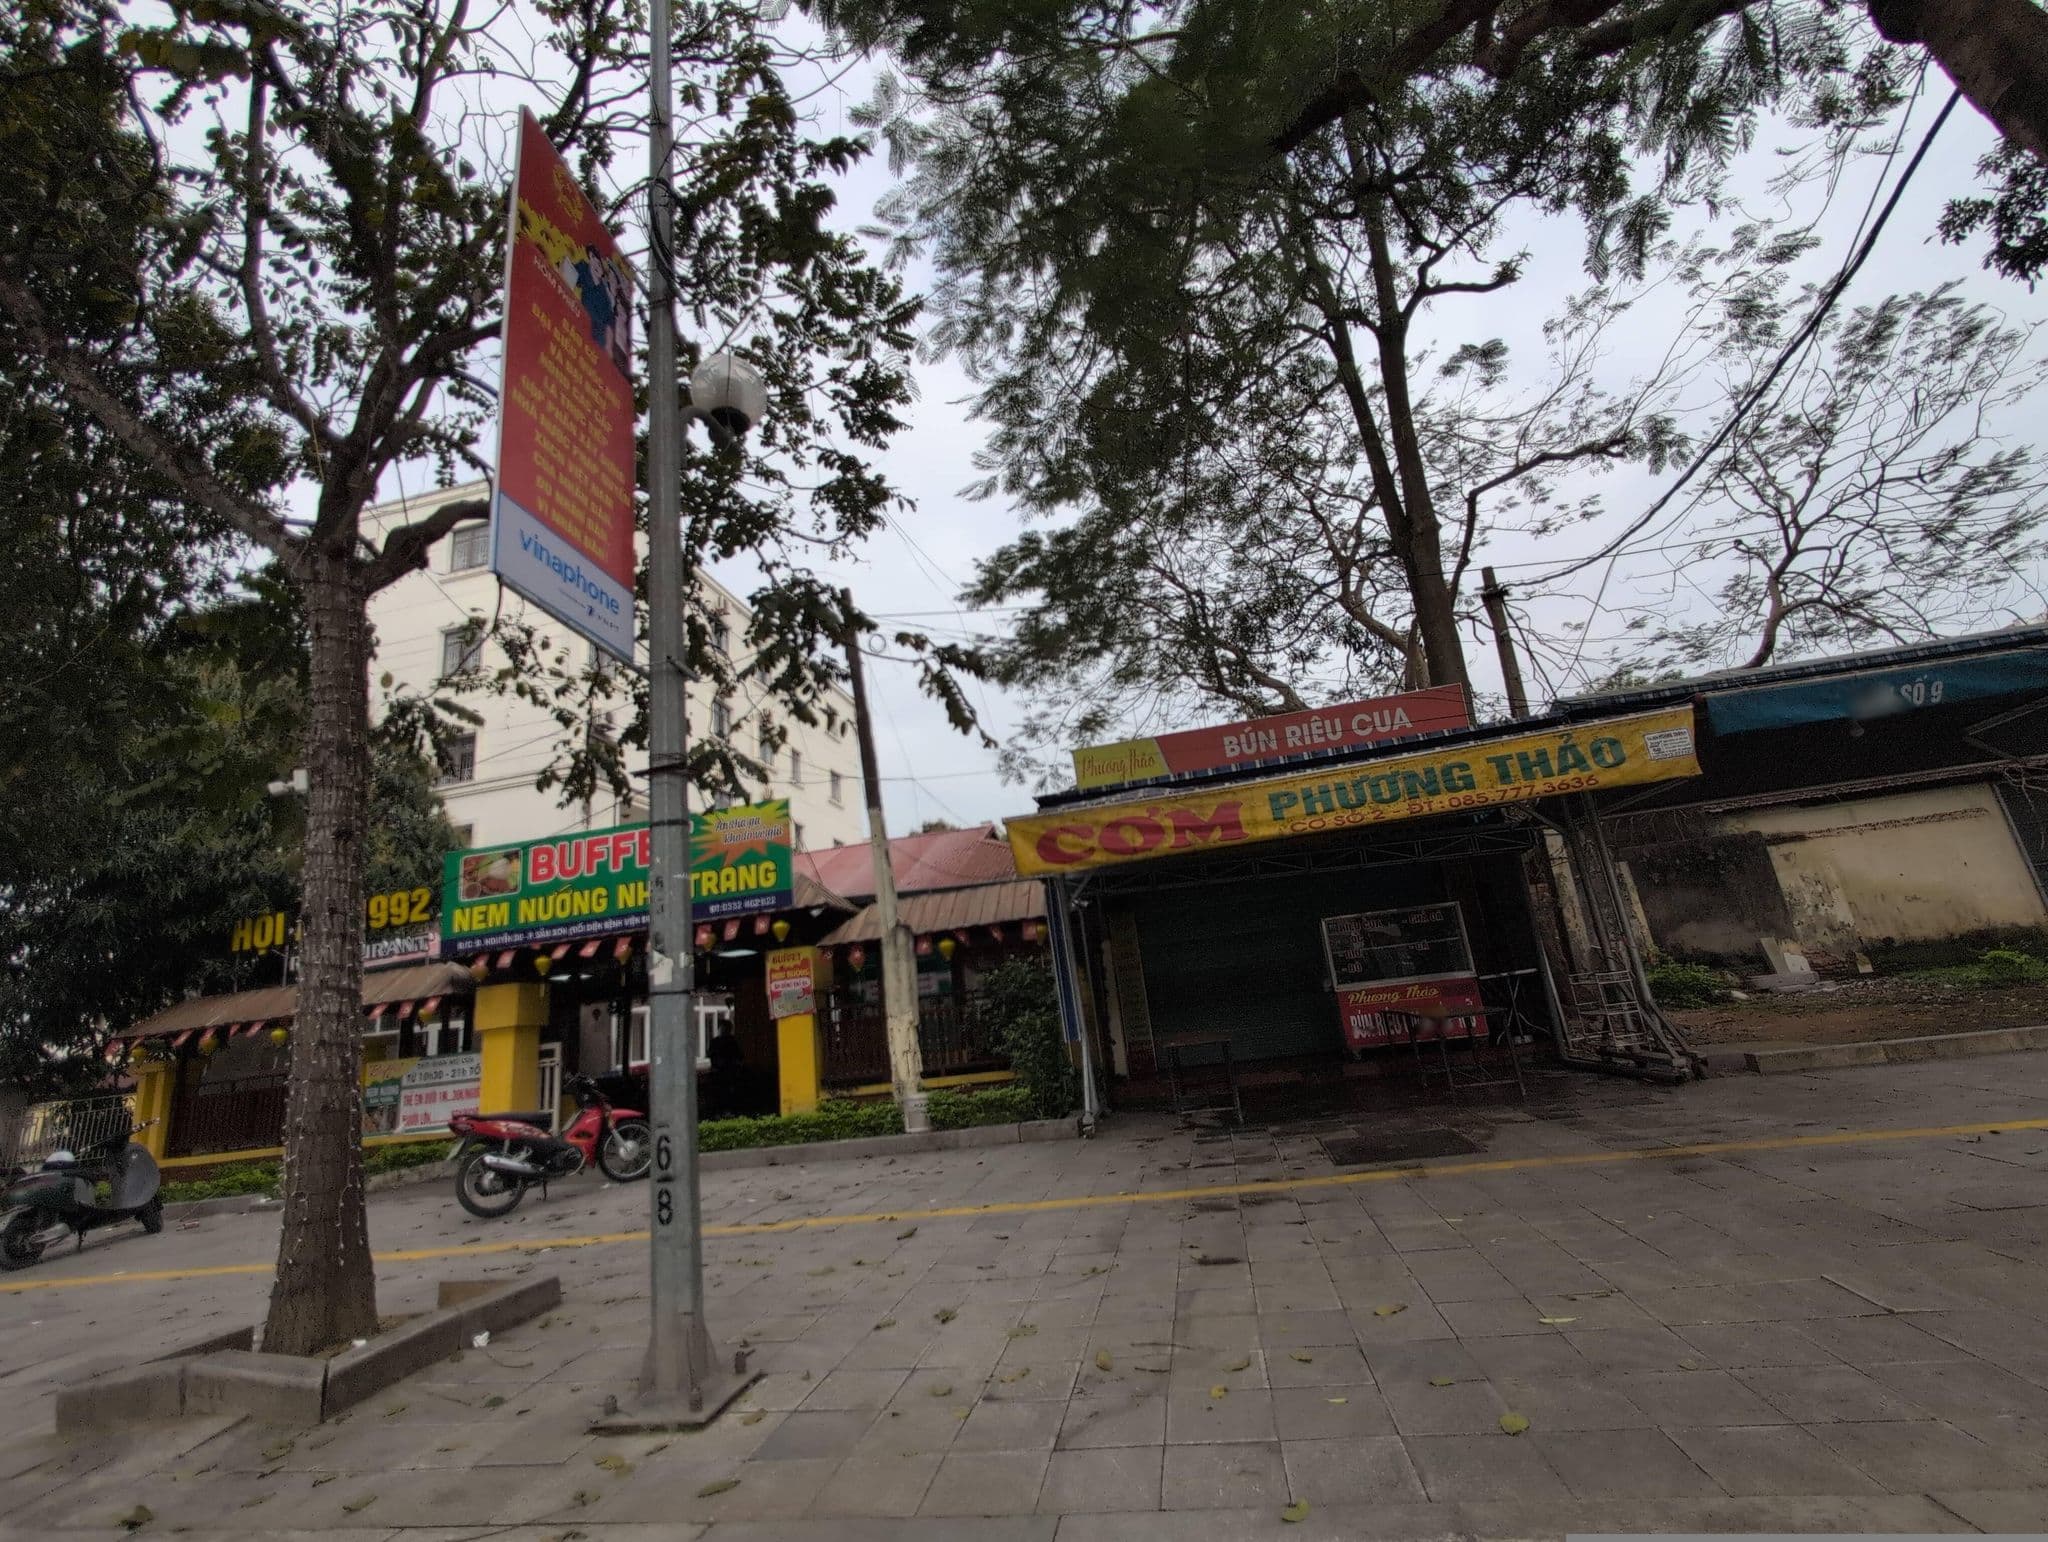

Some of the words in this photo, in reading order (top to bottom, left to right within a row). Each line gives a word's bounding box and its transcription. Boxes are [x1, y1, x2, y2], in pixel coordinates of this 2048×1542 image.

[519, 527, 620, 615] vinaphone
[1223, 727, 1278, 757] BÚN
[1285, 715, 1343, 748] RIÊU
[1352, 708, 1413, 736] CUA
[1268, 760, 1476, 821] PHƯƠNG
[1486, 733, 1627, 785] THẢO
[529, 824, 693, 885] BUFFE
[1036, 800, 1249, 864] CƠM
[365, 887, 432, 928] 992
[453, 901, 510, 933] NEM
[518, 884, 608, 925] NƯỚNG
[616, 880, 651, 909] NH
[689, 860, 777, 898] TRANG
